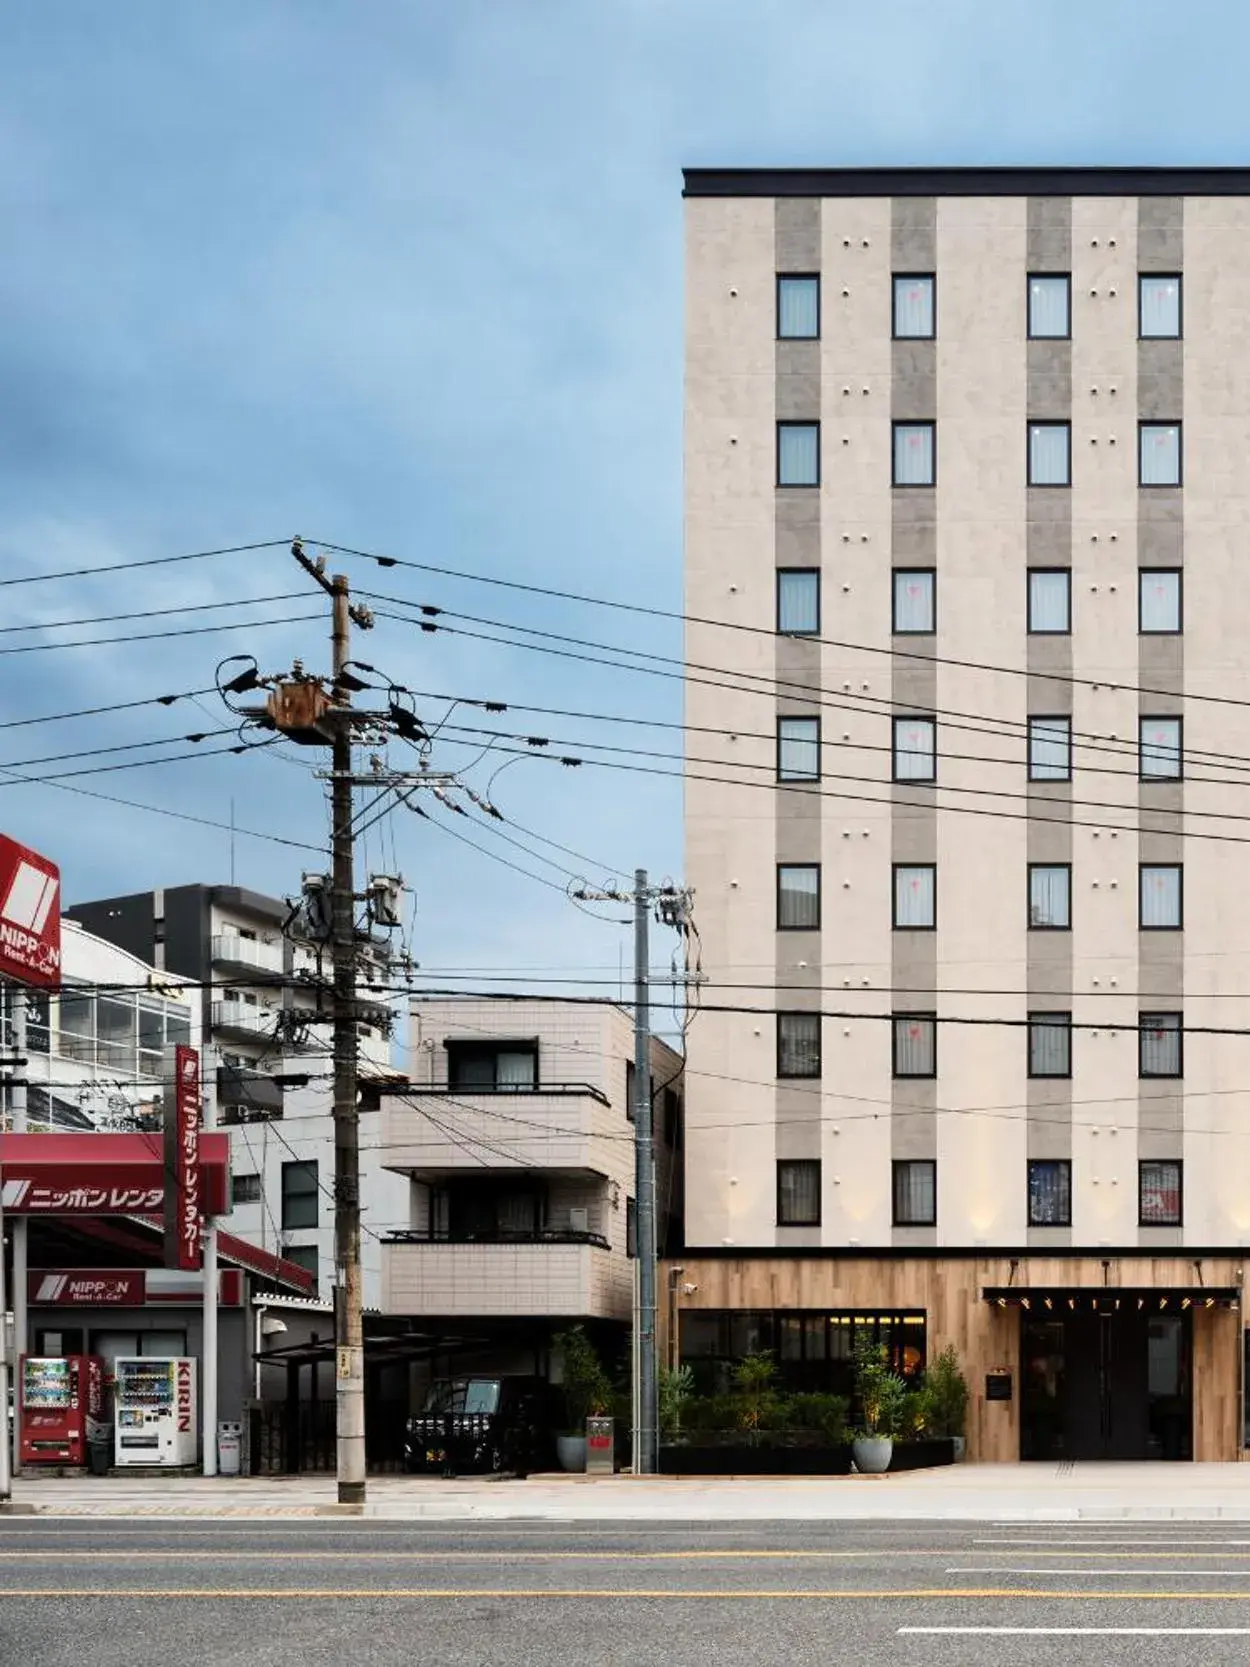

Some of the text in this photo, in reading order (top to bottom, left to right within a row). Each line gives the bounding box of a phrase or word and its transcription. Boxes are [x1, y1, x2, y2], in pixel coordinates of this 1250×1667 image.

[29, 1188, 164, 1208] ニッポンレンタ
[177, 1361, 191, 1433] KIRIN
